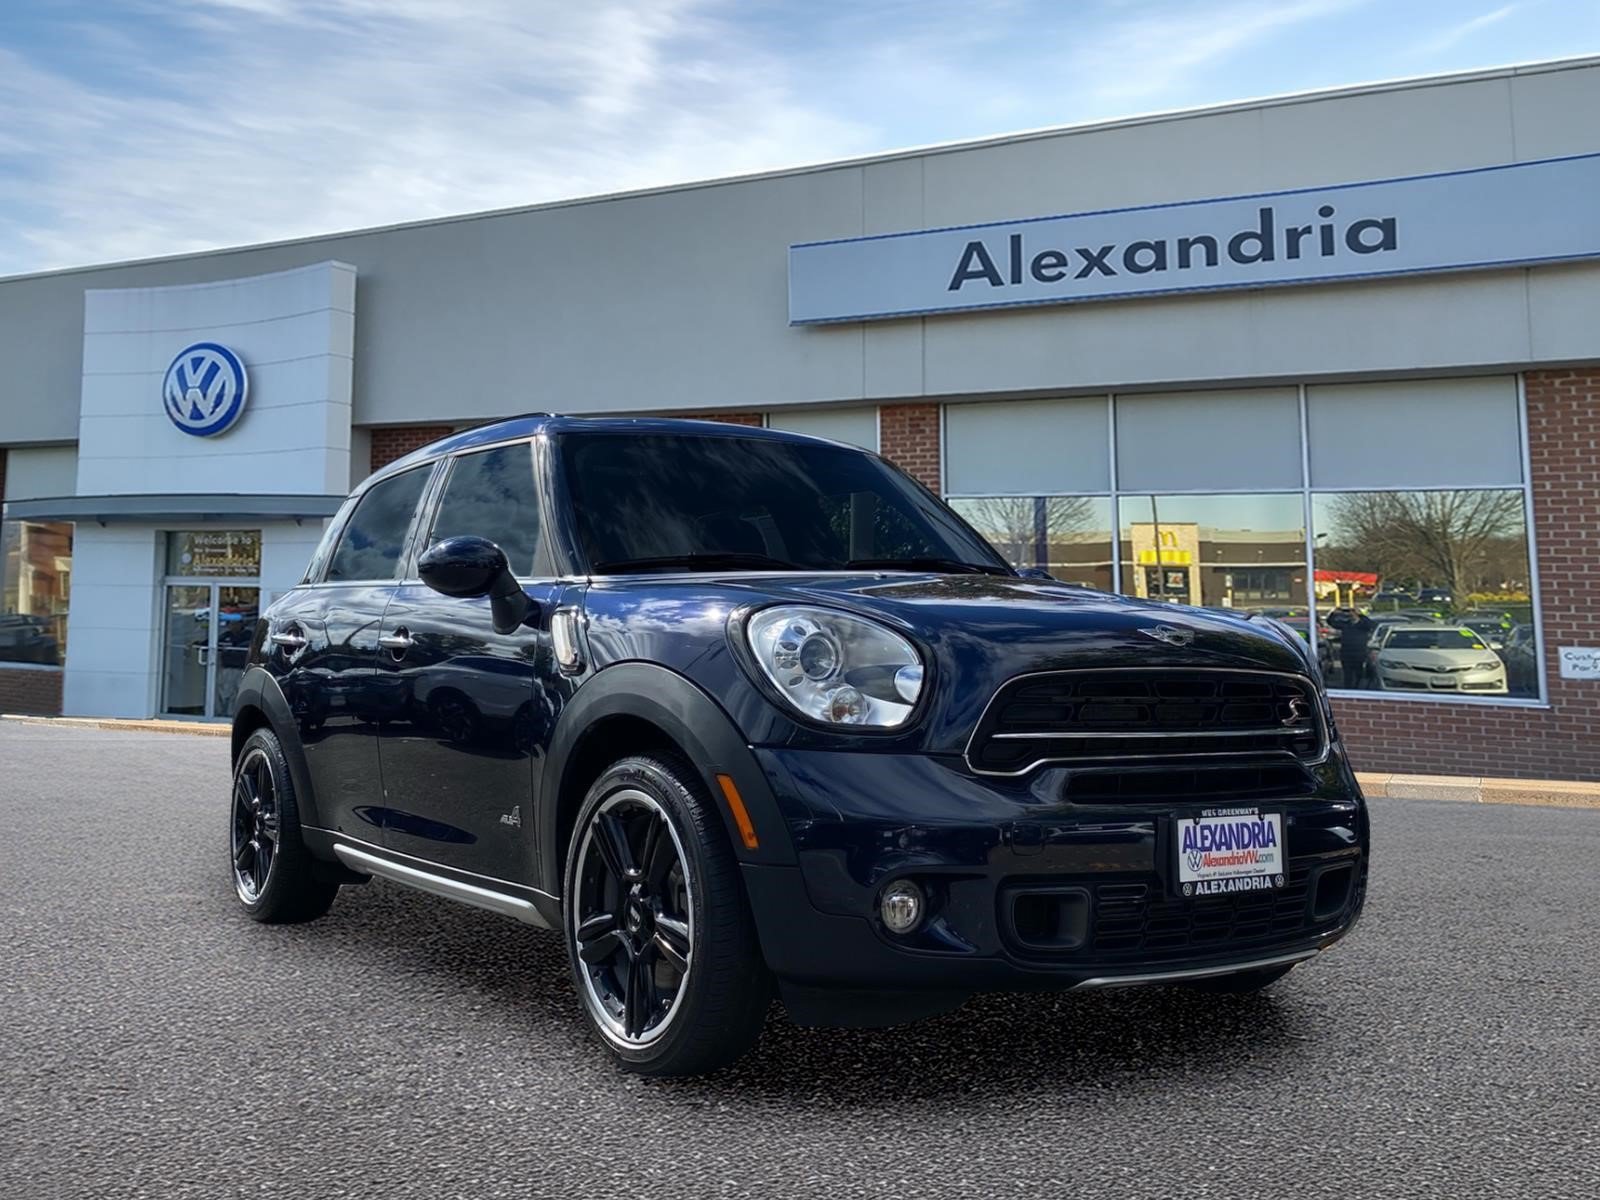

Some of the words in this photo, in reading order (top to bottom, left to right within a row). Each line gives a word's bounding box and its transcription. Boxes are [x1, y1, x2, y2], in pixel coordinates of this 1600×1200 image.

[947, 204, 1398, 291] Alexandria
[1182, 821, 1276, 853] ALEXANDRIA
[1195, 876, 1272, 895] ALEXANDRIA
